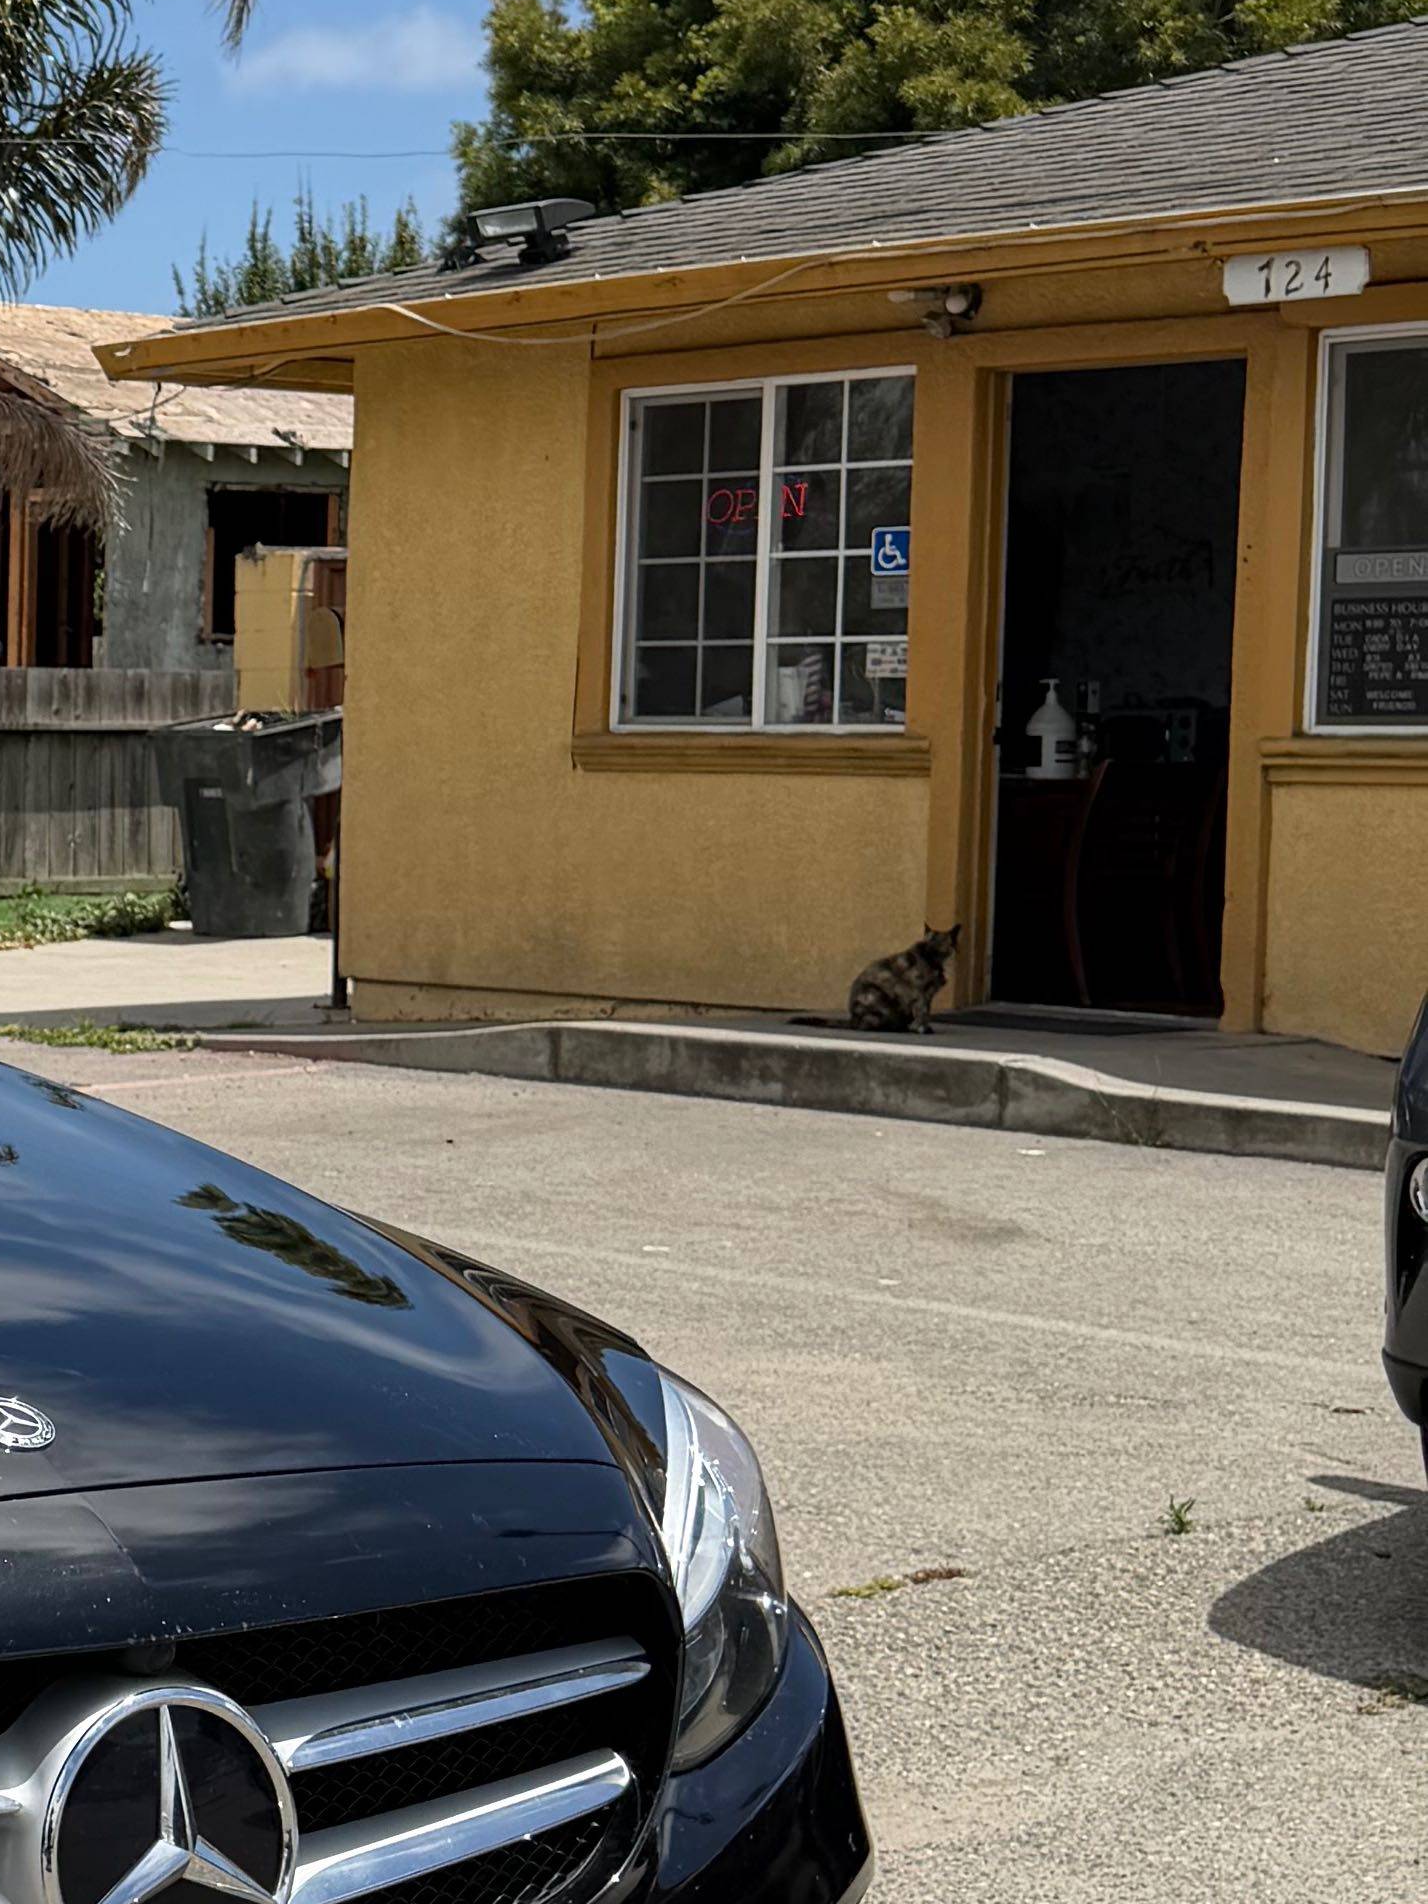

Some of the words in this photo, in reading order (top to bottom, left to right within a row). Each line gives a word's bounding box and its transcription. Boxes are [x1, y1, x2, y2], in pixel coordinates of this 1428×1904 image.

[706, 481, 808, 524] OPN
[1354, 556, 1425, 577] OPEN
[1334, 602, 1389, 616] BUSINESS
[1334, 620, 1363, 632] MON
[1334, 633, 1352, 646] TUE
[1331, 647, 1358, 659] WED
[1330, 689, 1349, 701] SAT
